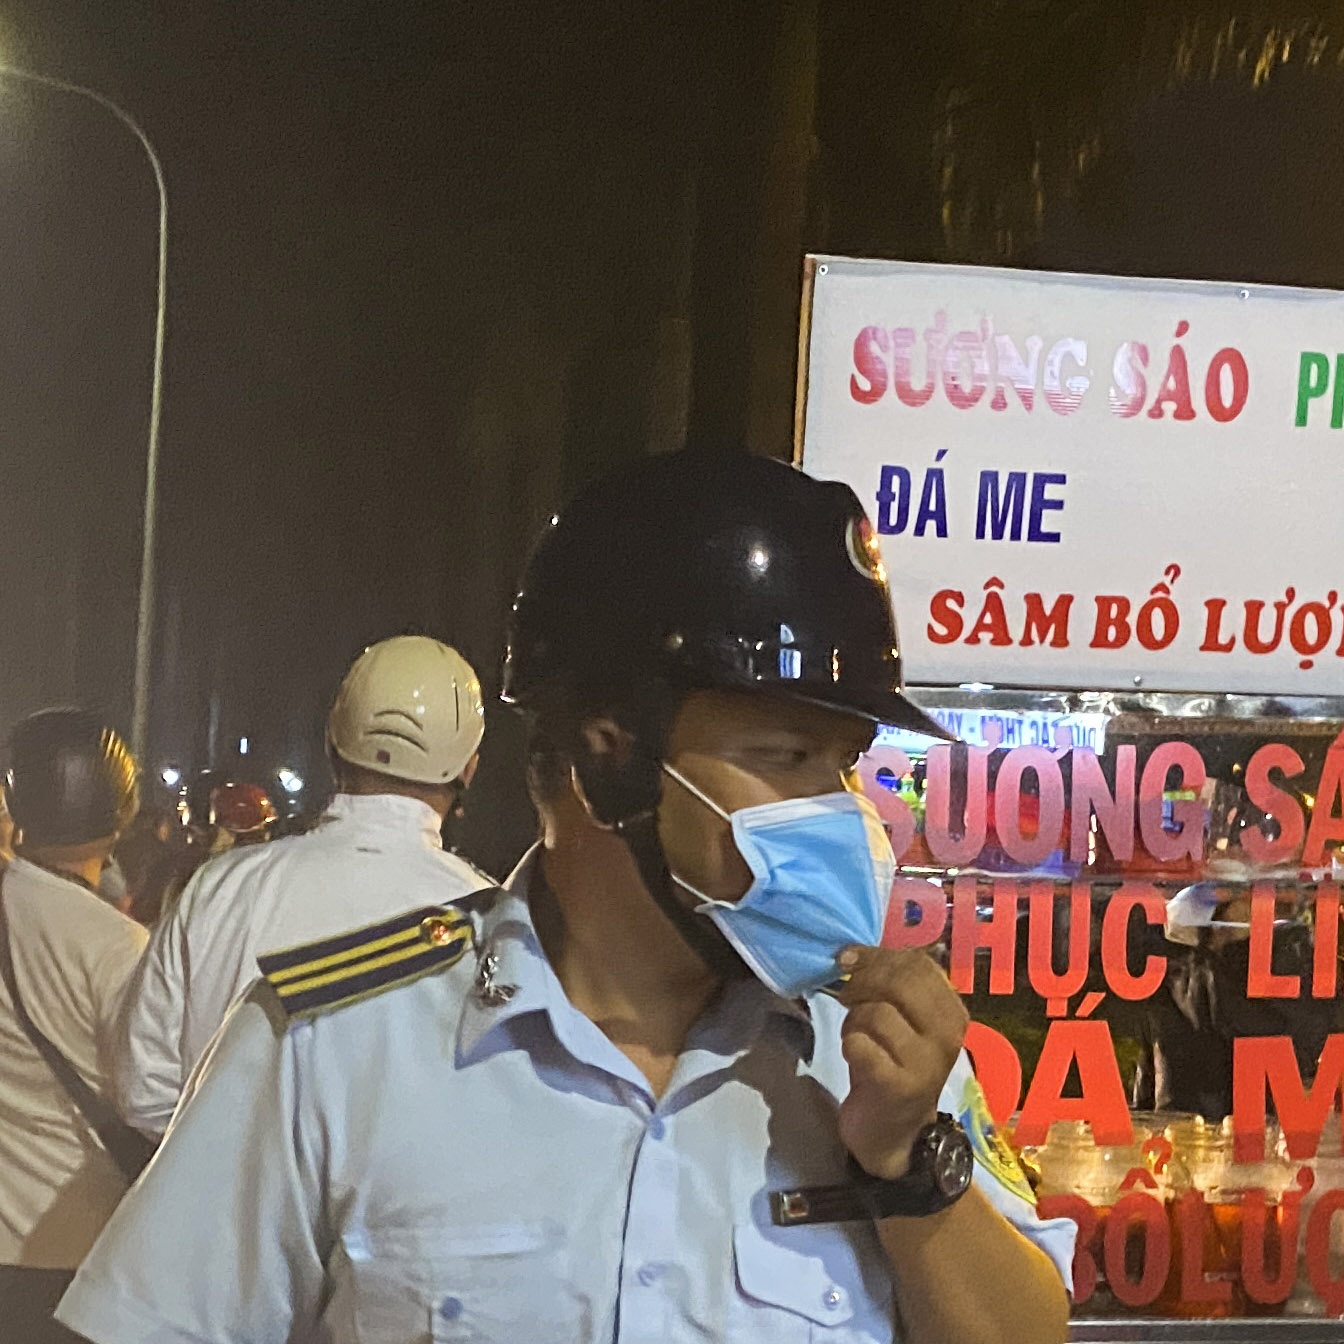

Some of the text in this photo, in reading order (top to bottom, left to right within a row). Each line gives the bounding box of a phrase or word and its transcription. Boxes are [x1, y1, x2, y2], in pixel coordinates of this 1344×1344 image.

[850, 308, 1090, 416] SƯƠNG
[1109, 320, 1251, 423] SÁO
[875, 448, 1068, 543] ĐÁ ME
[927, 575, 1074, 648] SÂM
[1089, 562, 1183, 651] BỔ
[860, 721, 1207, 864] SƯƠNG
[881, 877, 1169, 1021] PHỤC
